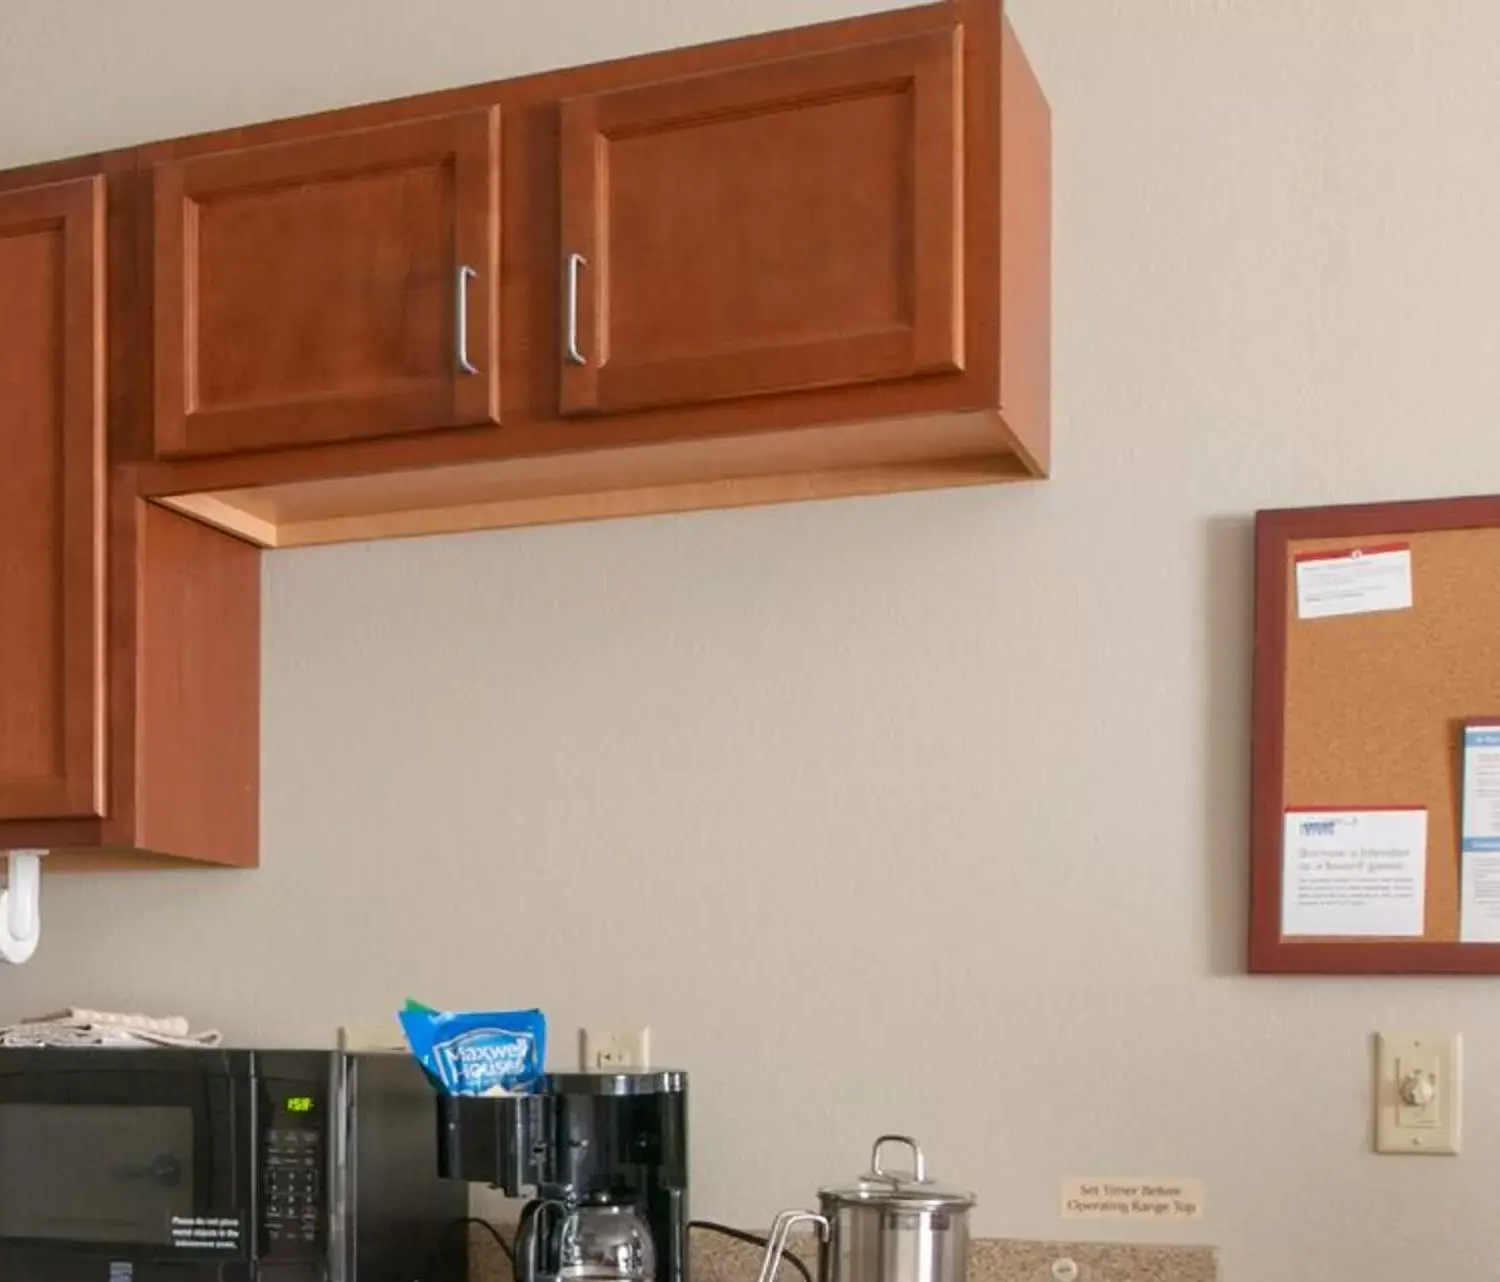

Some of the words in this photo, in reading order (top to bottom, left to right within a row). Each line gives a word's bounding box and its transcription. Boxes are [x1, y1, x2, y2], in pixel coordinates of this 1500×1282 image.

[443, 1037, 527, 1071] Maxwell
[459, 1058, 525, 1080] House
[1079, 1184, 1099, 1196] Set
[1103, 1184, 1138, 1197] Timer
[1141, 1184, 1182, 1197] Before
[1066, 1199, 1130, 1214] Operating
[1131, 1199, 1171, 1215] Range
[1172, 1200, 1198, 1216] Top
[172, 1216, 194, 1226] Please
